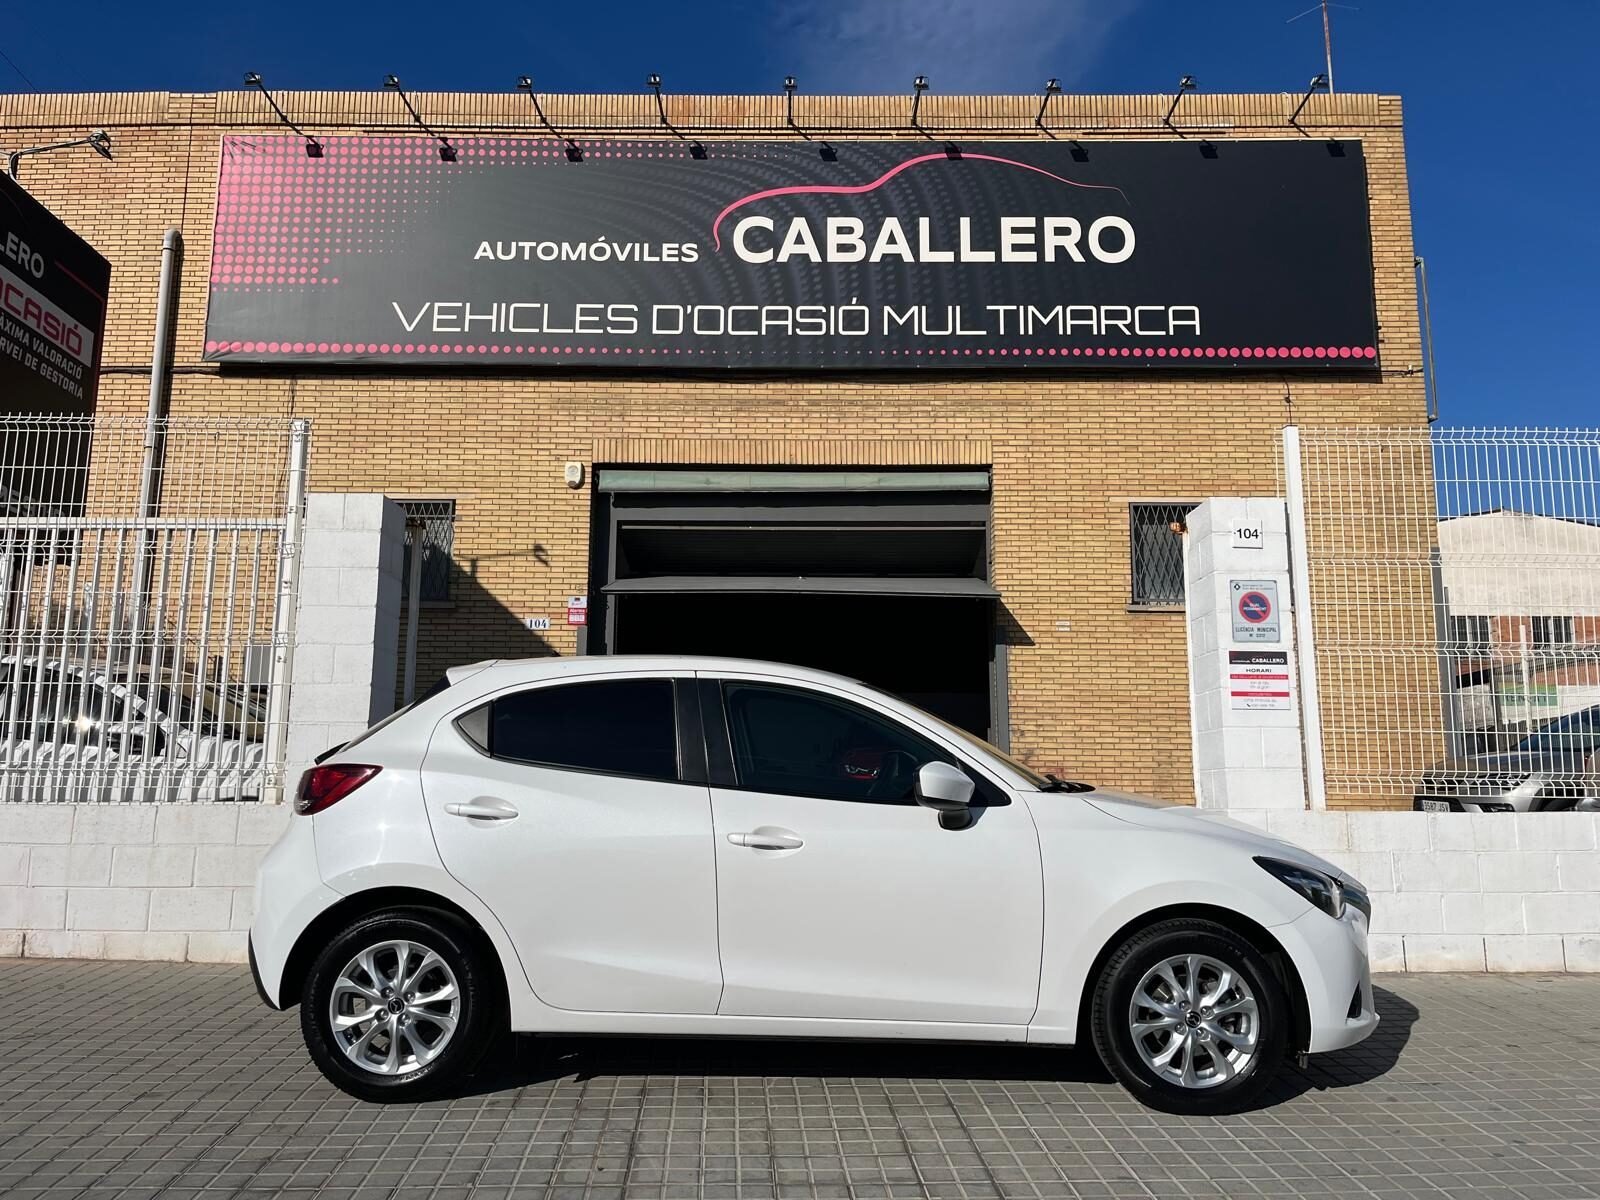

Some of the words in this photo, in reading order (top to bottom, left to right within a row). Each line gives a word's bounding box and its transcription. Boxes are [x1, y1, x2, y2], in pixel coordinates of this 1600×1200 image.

[473, 236, 699, 263] AUTOMÓVILES
[733, 215, 1136, 264] CABALLERO
[0, 277, 82, 357] CASIÓ
[392, 301, 639, 336] VEHICLES
[652, 297, 869, 336] D'OCASIÓ
[884, 304, 1201, 336] MULTIMARCA
[24, 352, 39, 371] DE
[40, 363, 84, 400] GESTORIA
[32, 336, 83, 380] VALORACIÓ
[1237, 528, 1259, 539] 104
[529, 619, 547, 629] 104
